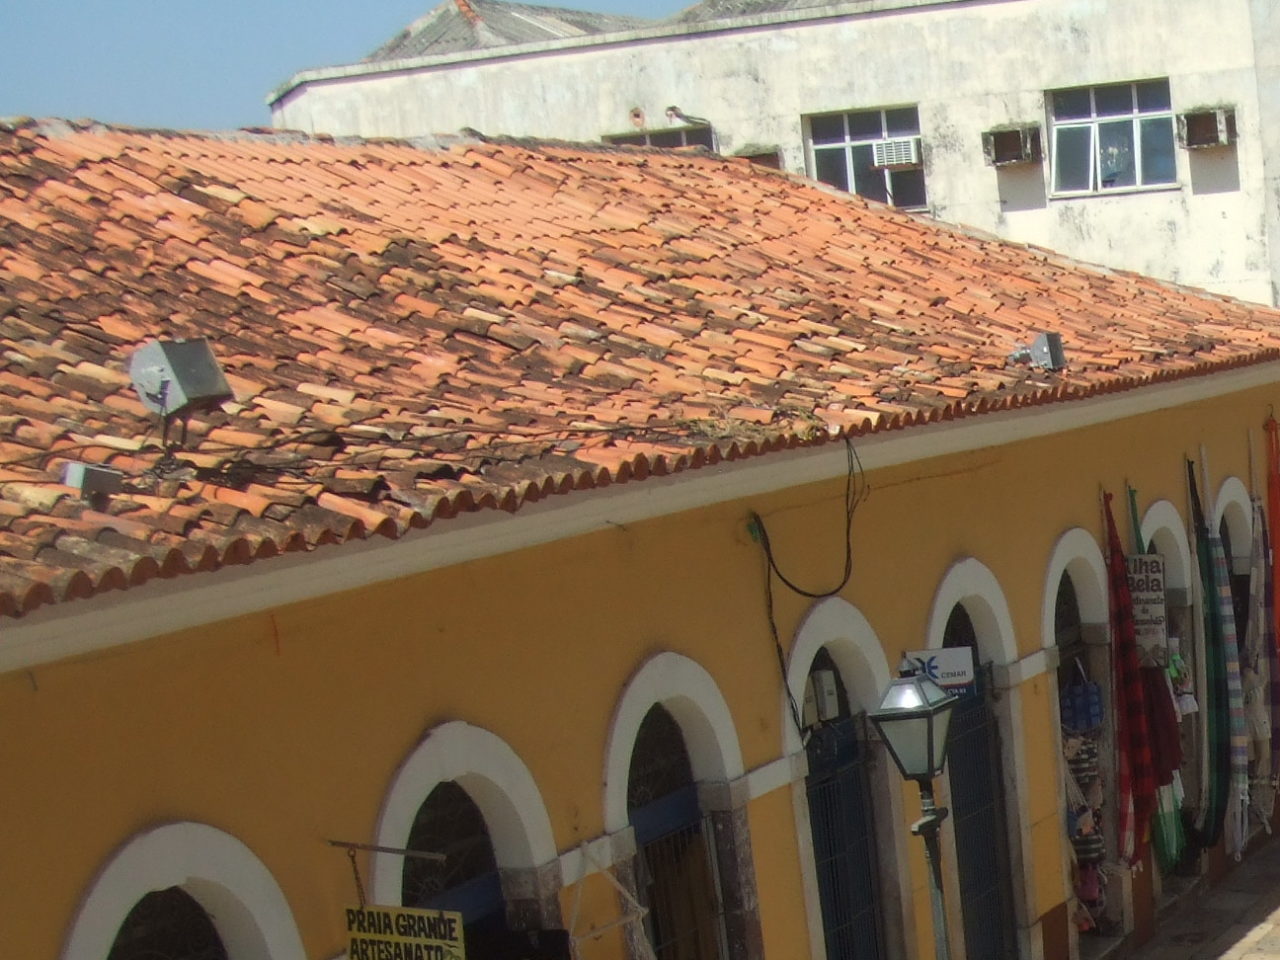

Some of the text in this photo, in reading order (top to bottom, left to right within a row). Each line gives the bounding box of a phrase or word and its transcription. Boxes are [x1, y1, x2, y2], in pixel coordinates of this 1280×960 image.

[1127, 574, 1163, 592] Bela
[346, 909, 458, 941] PRAIA GRANDE
